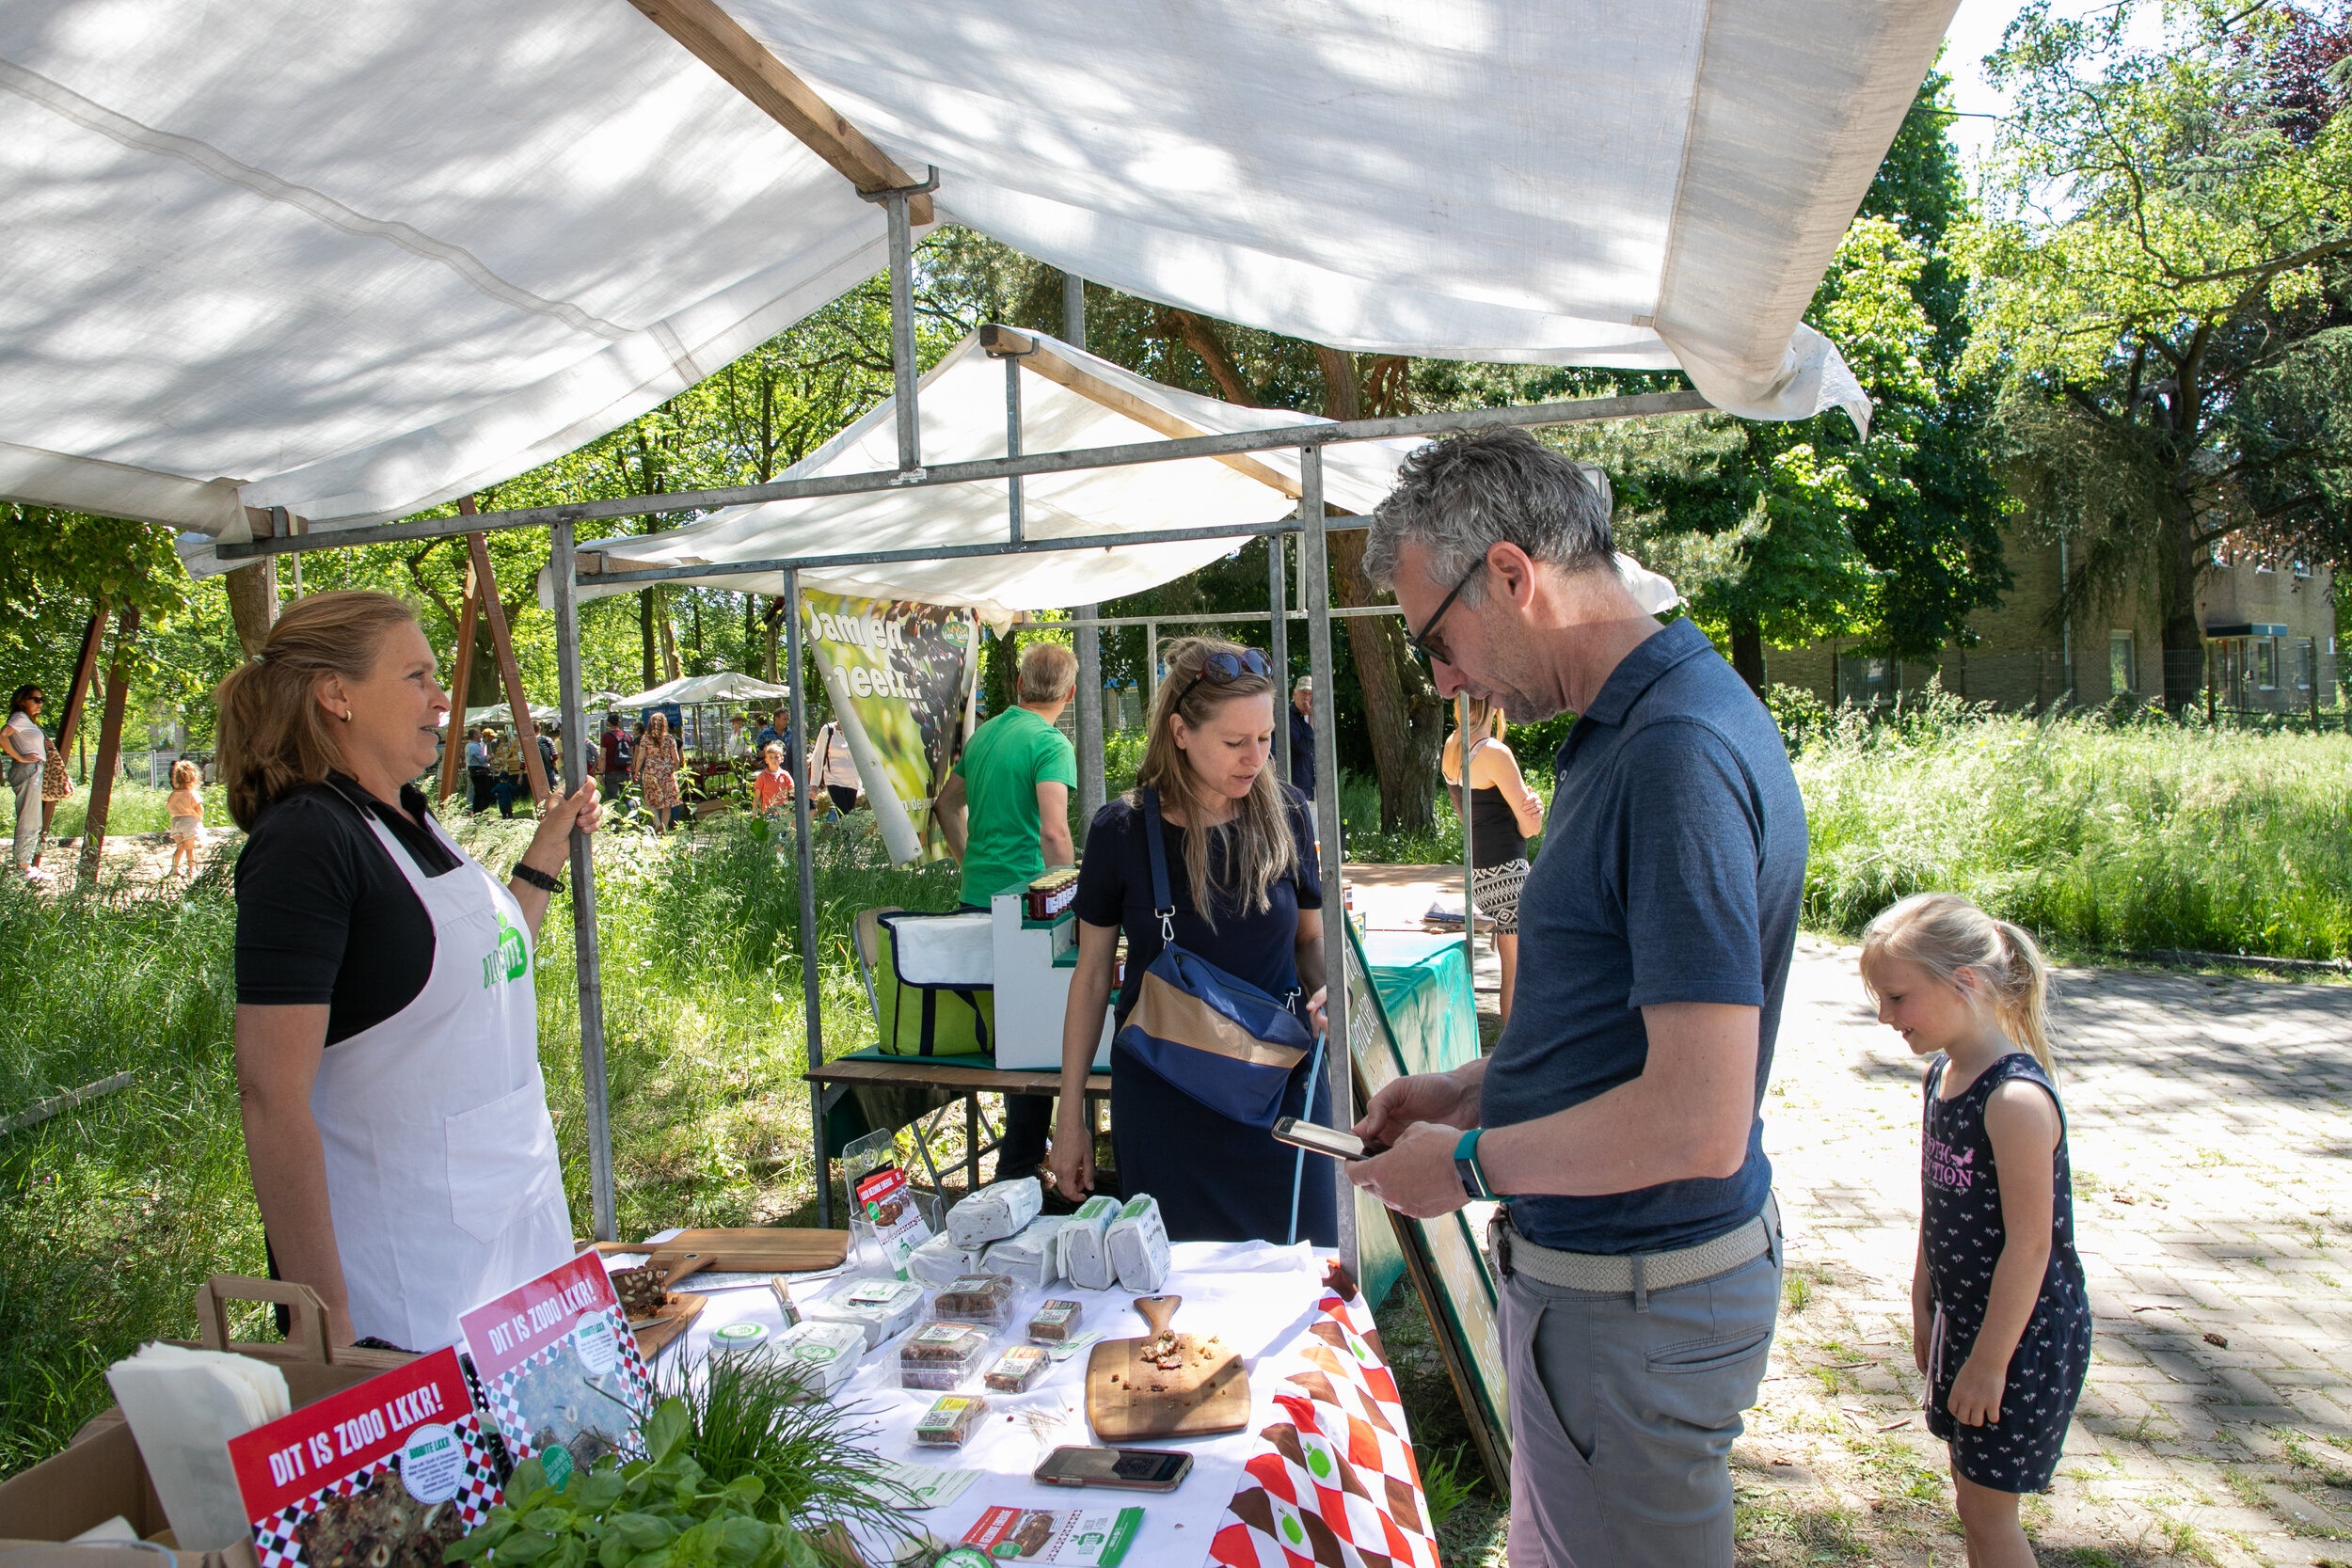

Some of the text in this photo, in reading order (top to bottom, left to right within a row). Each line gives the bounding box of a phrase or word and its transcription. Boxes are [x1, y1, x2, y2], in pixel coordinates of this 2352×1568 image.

[912, 796, 922, 811] de
[482, 936, 523, 990] BIOBITE
[487, 1277, 597, 1356] DIT IS ZOOO LKKR!
[268, 1382, 444, 1488] DIT IS ZOOO LKKR!
